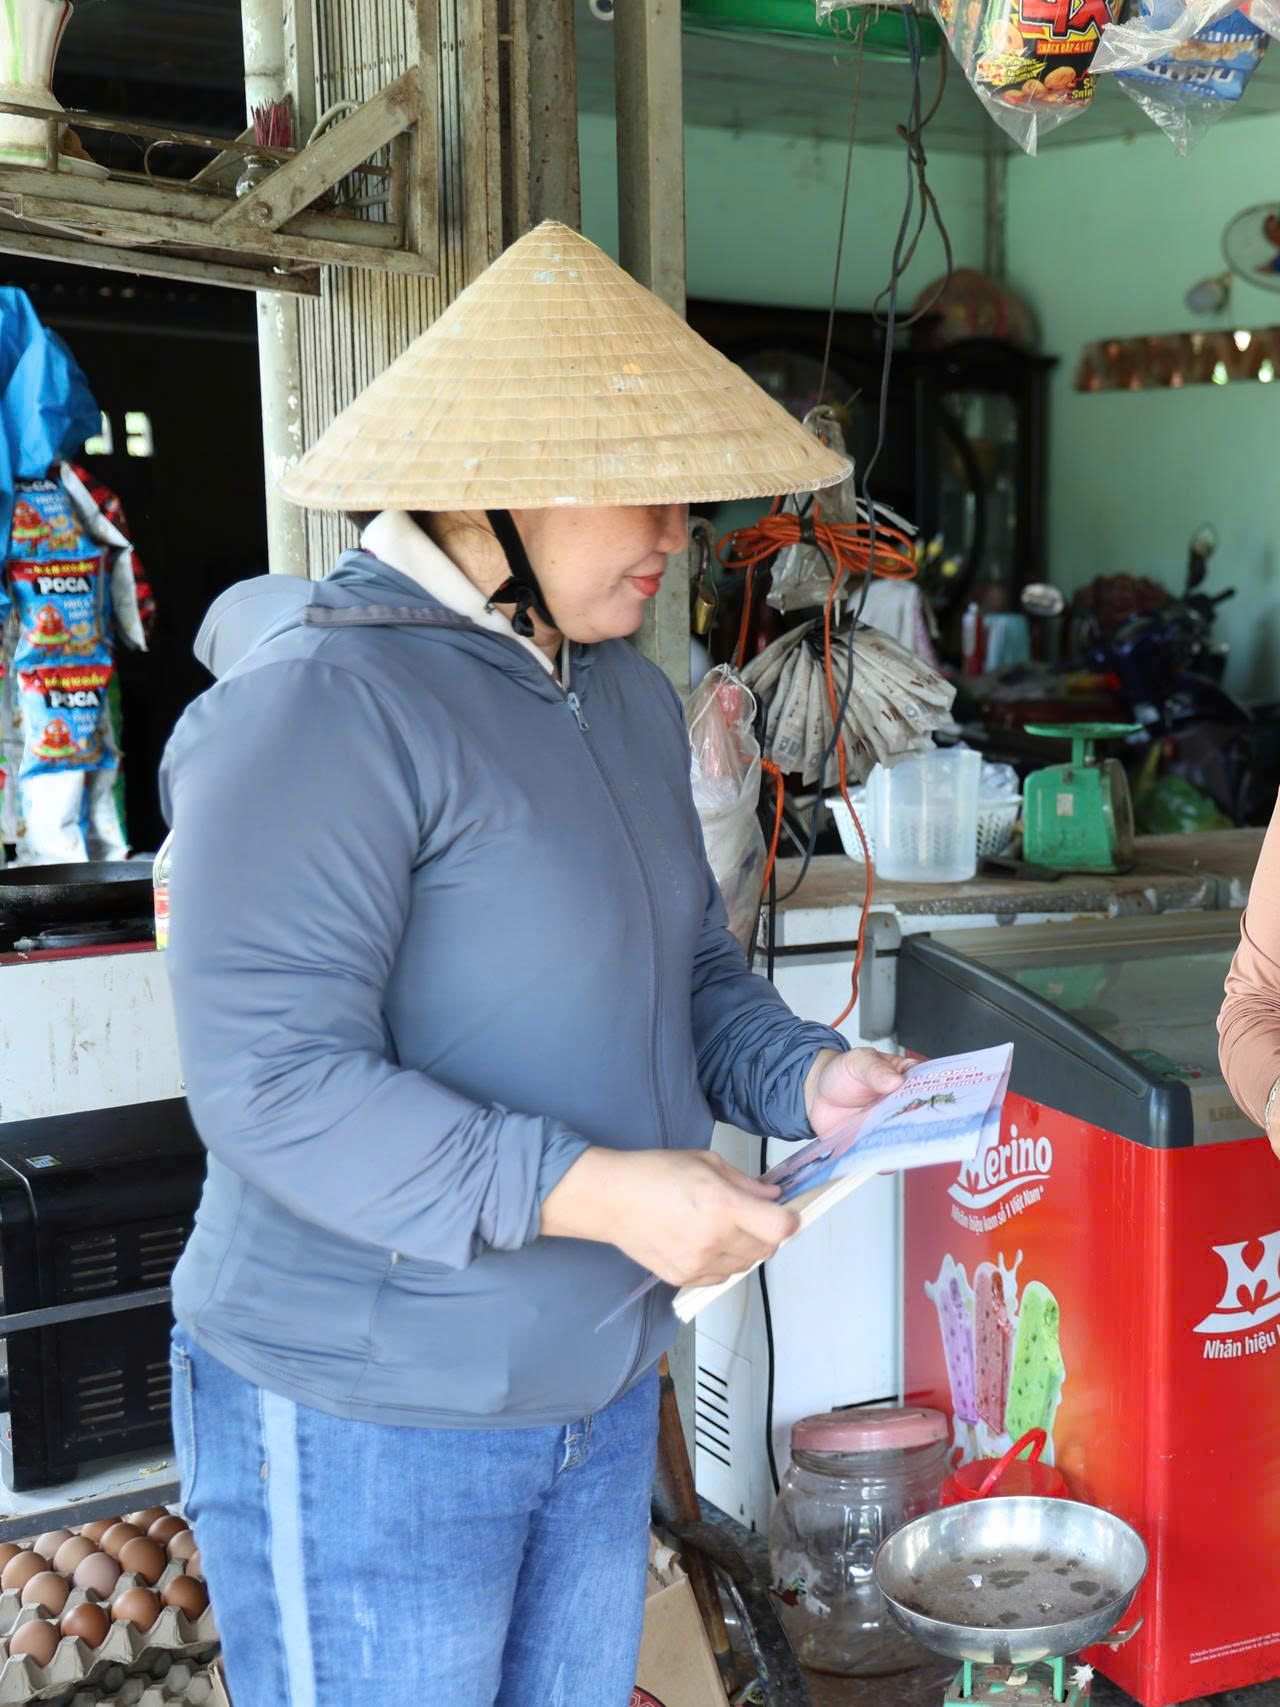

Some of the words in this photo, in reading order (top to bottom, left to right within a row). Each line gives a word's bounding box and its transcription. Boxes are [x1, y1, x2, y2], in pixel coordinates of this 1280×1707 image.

[37, 576, 90, 594] POCA
[50, 690, 100, 708] POCA
[957, 1123, 1054, 1190] Merino
[1203, 1339, 1242, 1359] Nhãn
[1244, 1331, 1277, 1354] hiệu
